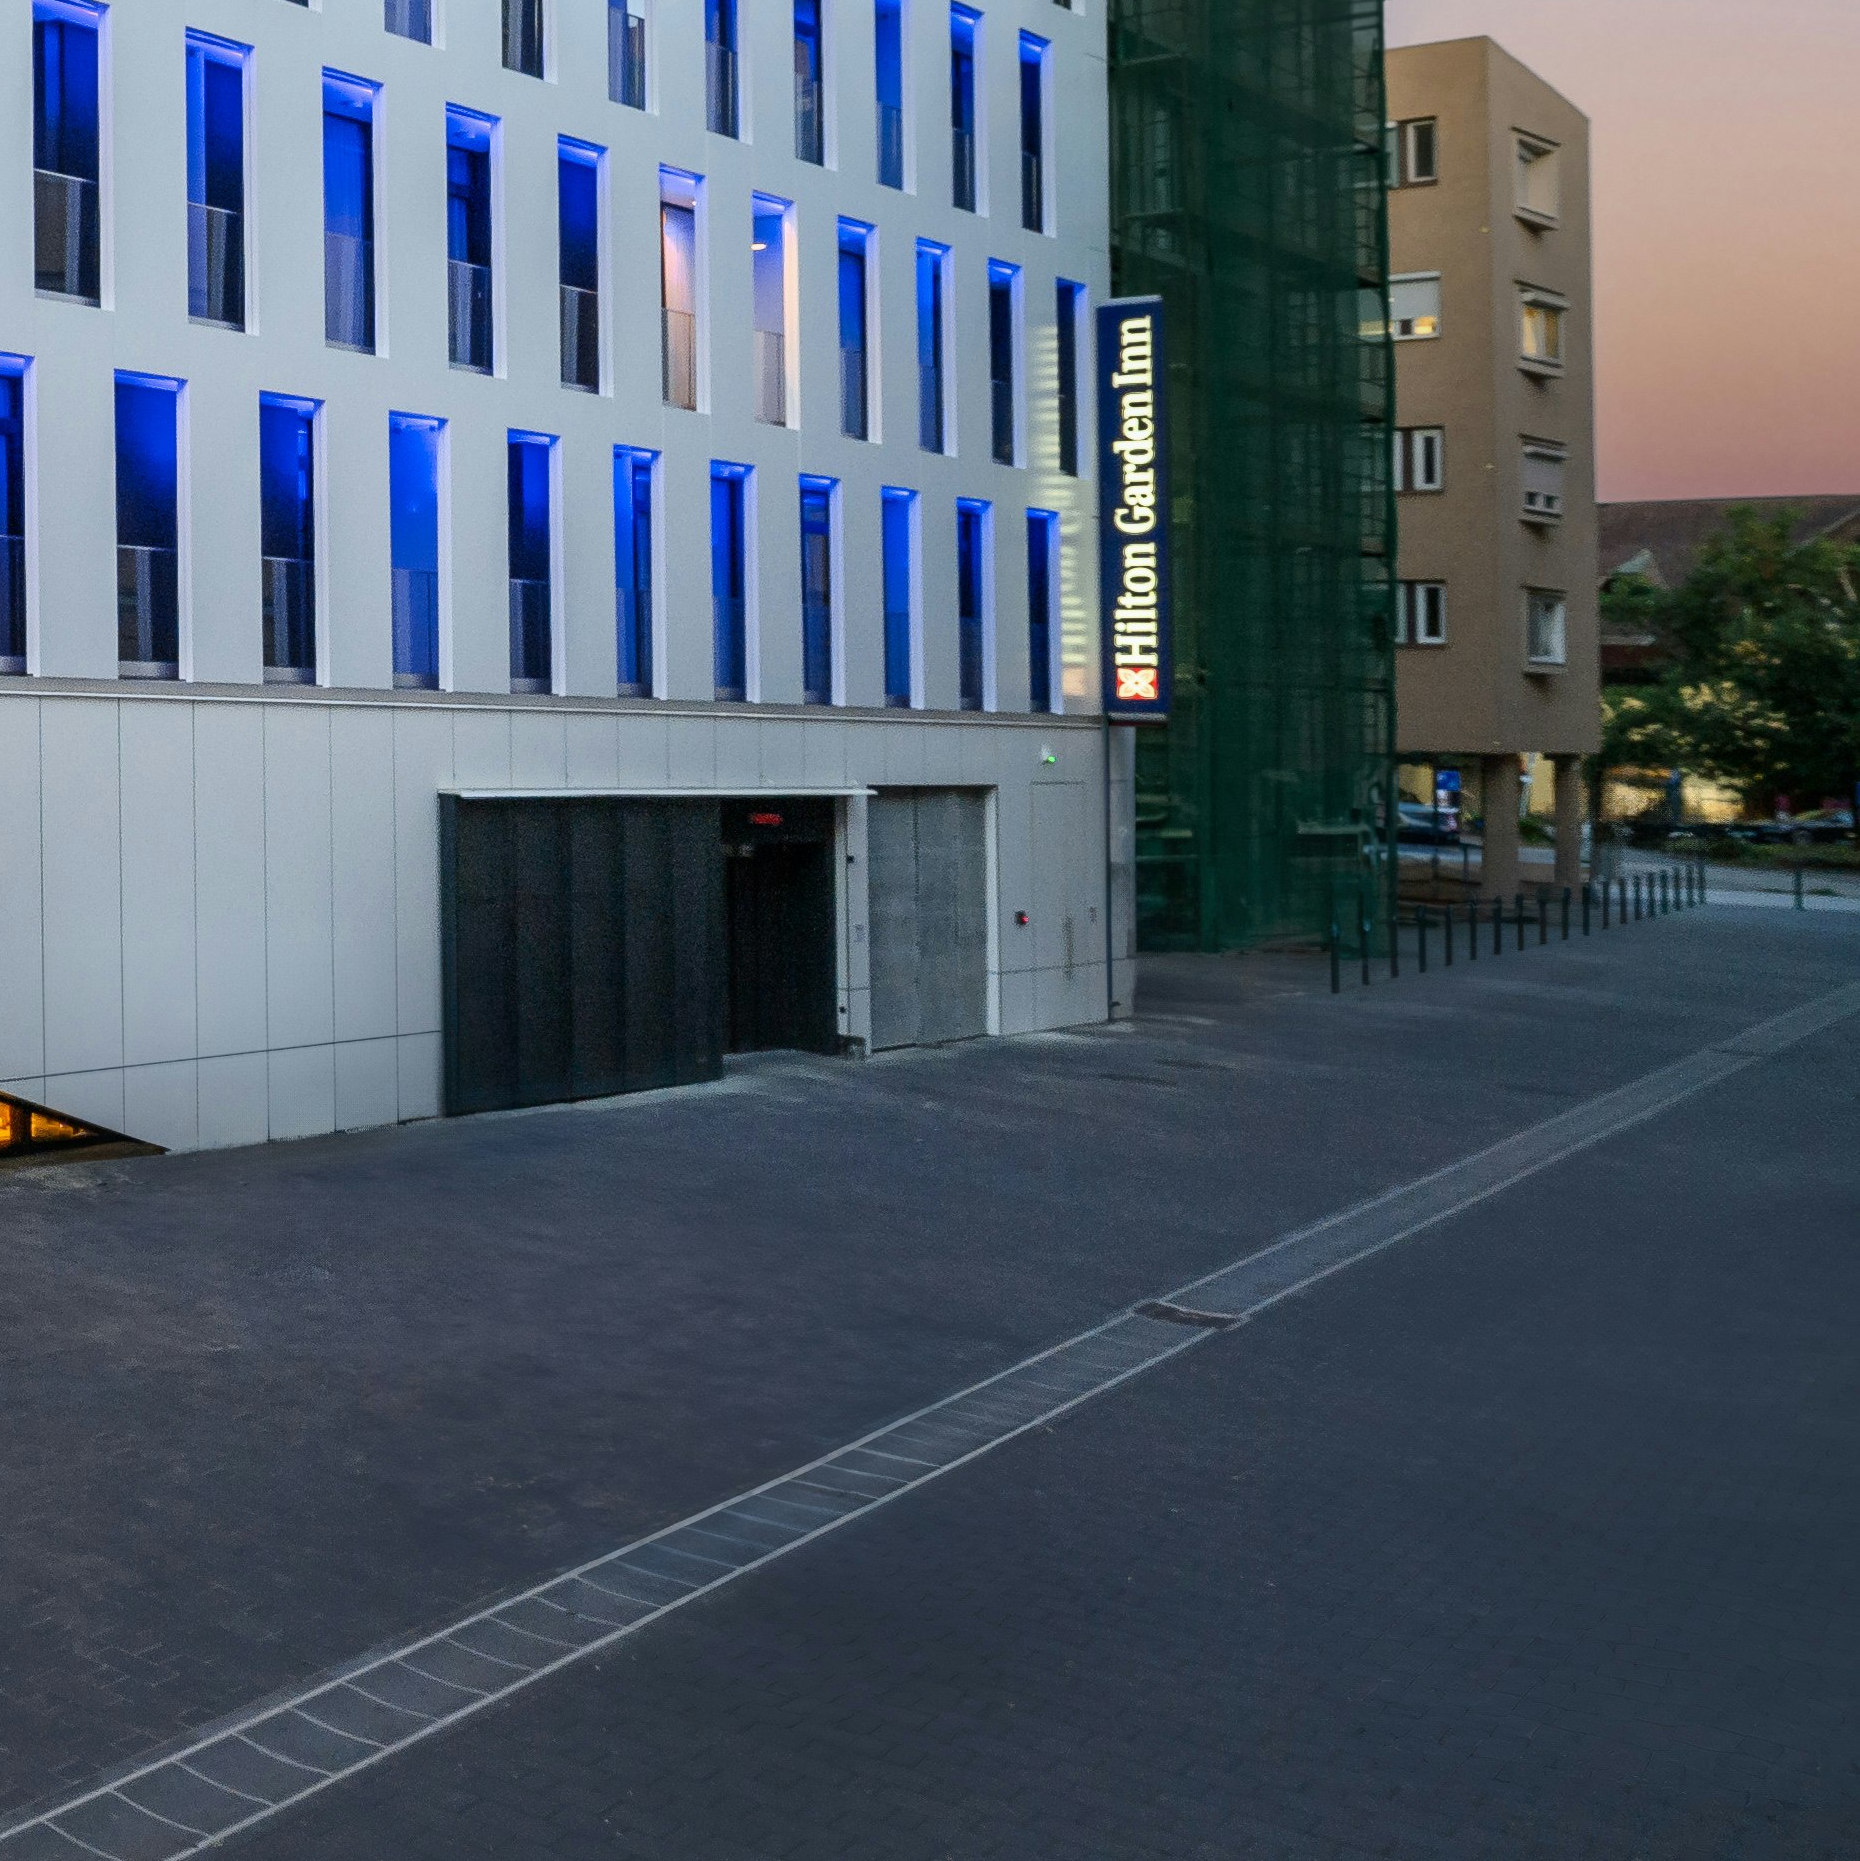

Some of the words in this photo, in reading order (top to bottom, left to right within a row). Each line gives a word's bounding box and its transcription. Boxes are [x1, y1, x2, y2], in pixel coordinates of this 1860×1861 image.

[1112, 315, 1154, 389] Inn
[1112, 391, 1157, 534] Garden
[1114, 542, 1158, 667] Hilton
